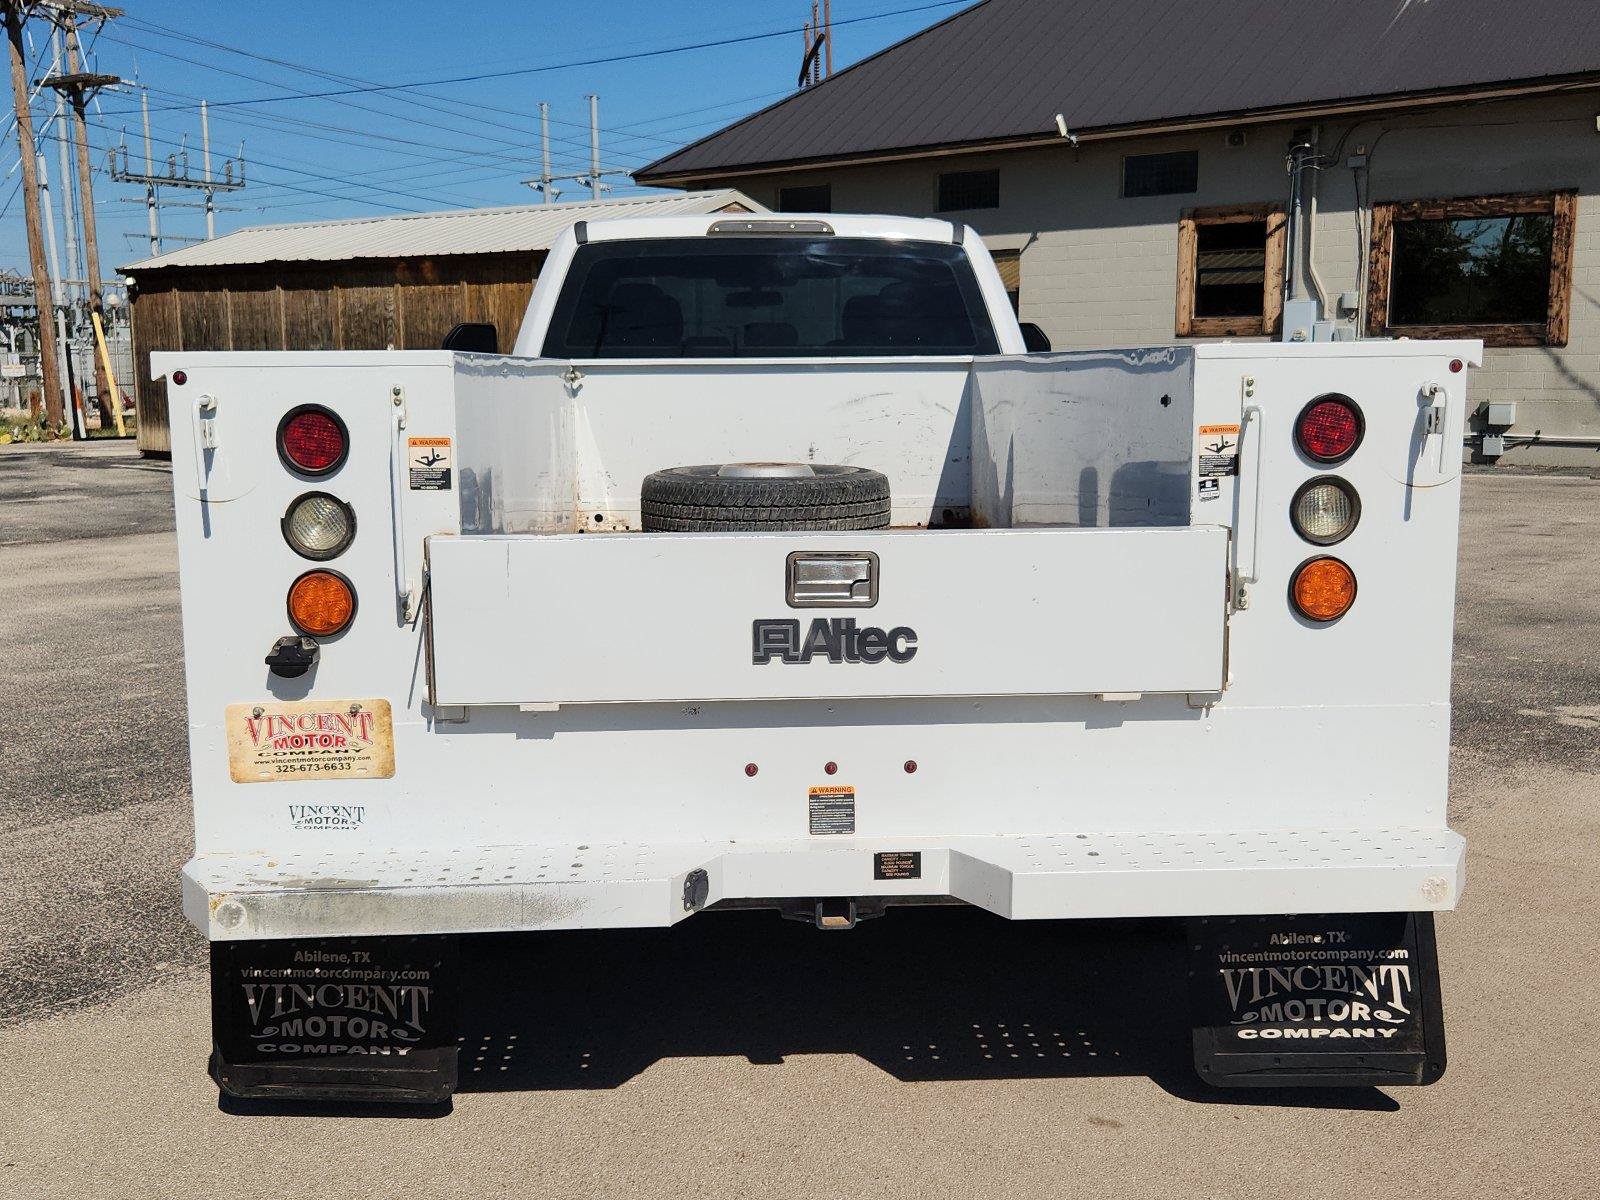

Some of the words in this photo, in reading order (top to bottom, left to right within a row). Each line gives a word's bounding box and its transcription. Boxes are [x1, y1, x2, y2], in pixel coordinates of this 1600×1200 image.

[801, 617, 918, 665] Altec
[244, 711, 374, 746] VINCENT
[273, 733, 347, 750] MOTOR
[254, 755, 372, 765] www.vincentmotorcompany.com
[257, 748, 366, 758] COMPANY
[275, 762, 352, 773] 325-673-6633
[819, 786, 852, 794] WARNING
[288, 805, 365, 824] VINCENT
[304, 816, 347, 825] MOTOR
[1270, 931, 1326, 946] Abilene,
[1327, 931, 1346, 944] TX
[293, 950, 352, 964] Abilene,
[352, 951, 371, 963] TX
[1219, 949, 1409, 964] vincentmotorcompany.com
[241, 967, 430, 982] vincentmotorcompany.com
[1219, 965, 1412, 1015] VINCENT
[241, 983, 430, 1034] VINCENT
[1260, 998, 1371, 1022] MOTOR
[281, 1015, 389, 1039] MOTOR
[1237, 1028, 1398, 1040] COMPANY
[256, 1043, 413, 1056] COMPANY
